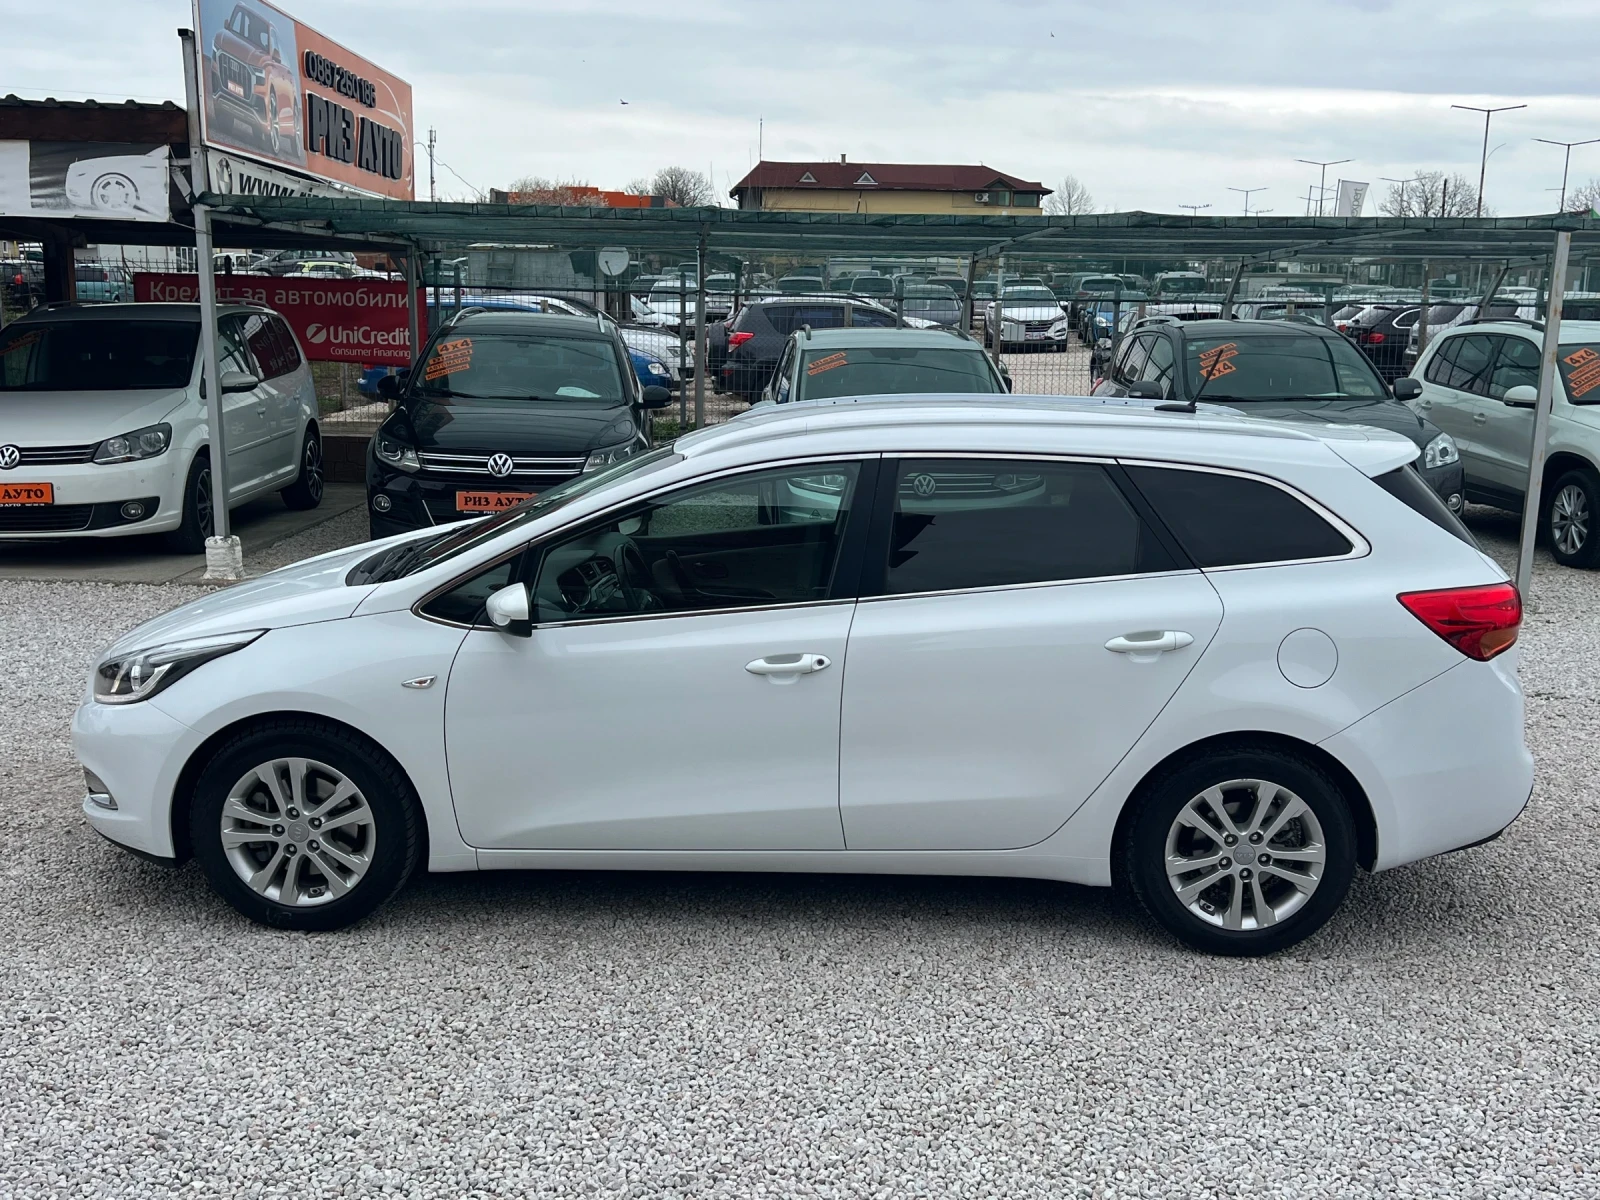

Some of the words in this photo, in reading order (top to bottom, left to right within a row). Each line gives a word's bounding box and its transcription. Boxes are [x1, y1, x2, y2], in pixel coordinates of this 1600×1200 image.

[306, 91, 355, 164] РИЗ
[357, 116, 402, 180] АУТО
[242, 287, 267, 303] за
[274, 288, 409, 309] автомобили
[329, 325, 411, 346] UniCredit
[330, 346, 371, 357] Consumer
[373, 347, 411, 360] Financing
[440, 339, 470, 352] 4x4
[1569, 349, 1596, 365] 4x4
[2, 488, 45, 500] АУТО
[494, 497, 532, 507] АУТ
